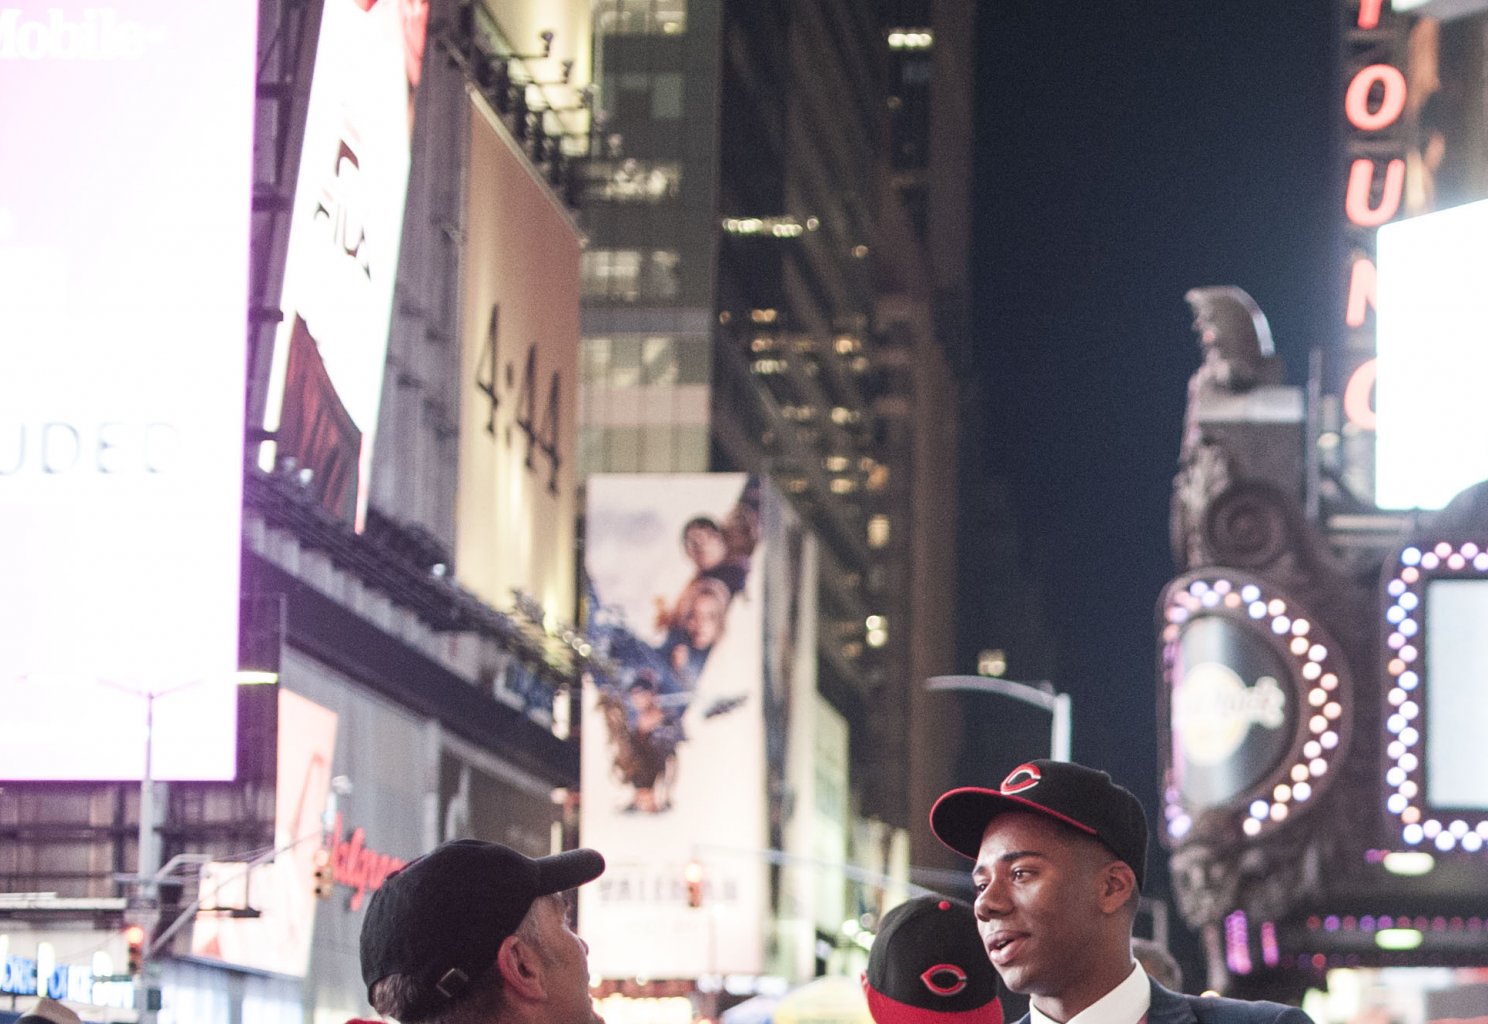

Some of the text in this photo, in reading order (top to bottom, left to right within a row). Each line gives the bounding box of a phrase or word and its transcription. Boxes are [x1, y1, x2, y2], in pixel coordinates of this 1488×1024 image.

[475, 302, 561, 496] 4:44
[1000, 763, 1042, 796] C
[920, 963, 968, 996] C
